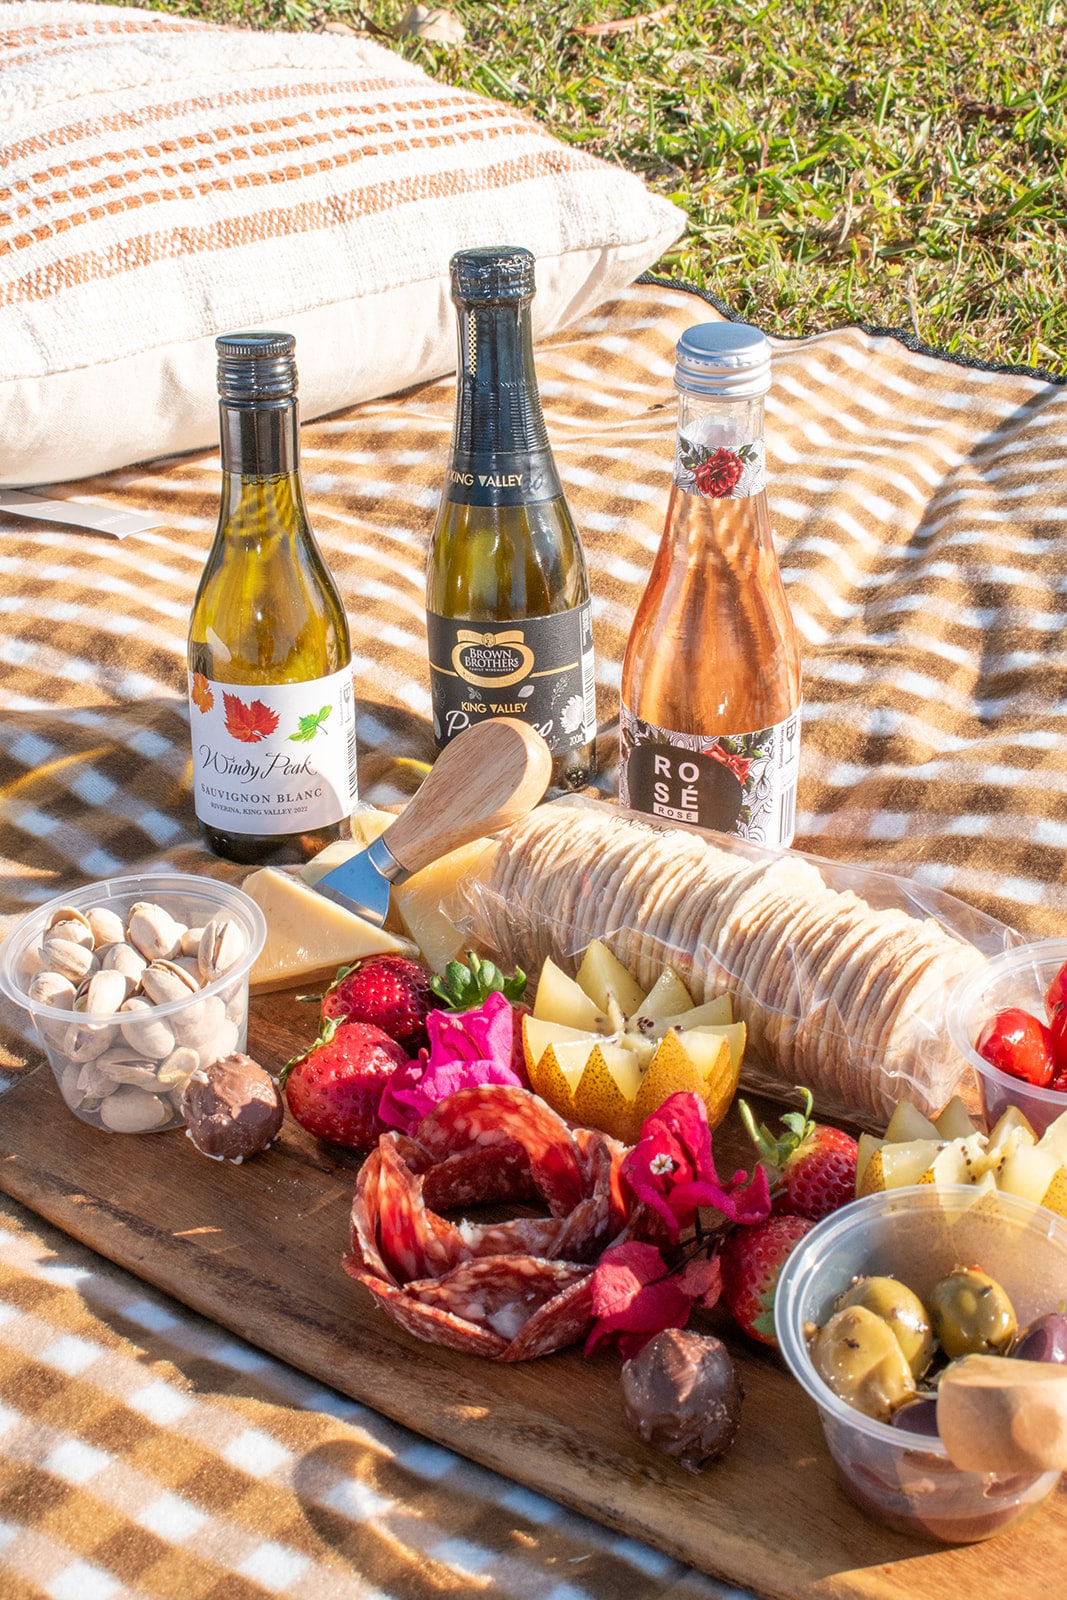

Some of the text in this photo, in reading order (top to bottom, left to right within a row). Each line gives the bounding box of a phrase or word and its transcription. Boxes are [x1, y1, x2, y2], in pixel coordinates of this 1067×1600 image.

[450, 470, 523, 487] KING VALLEY
[469, 647, 512, 659] BROWN
[464, 656, 519, 668] BROTHERS
[461, 701, 528, 713] KING VALLEY
[199, 744, 317, 784] Windy Peak
[201, 783, 322, 803] SAUVIGNON BLANC
[210, 801, 308, 815] RIVERINA, KING VALLEY 2022
